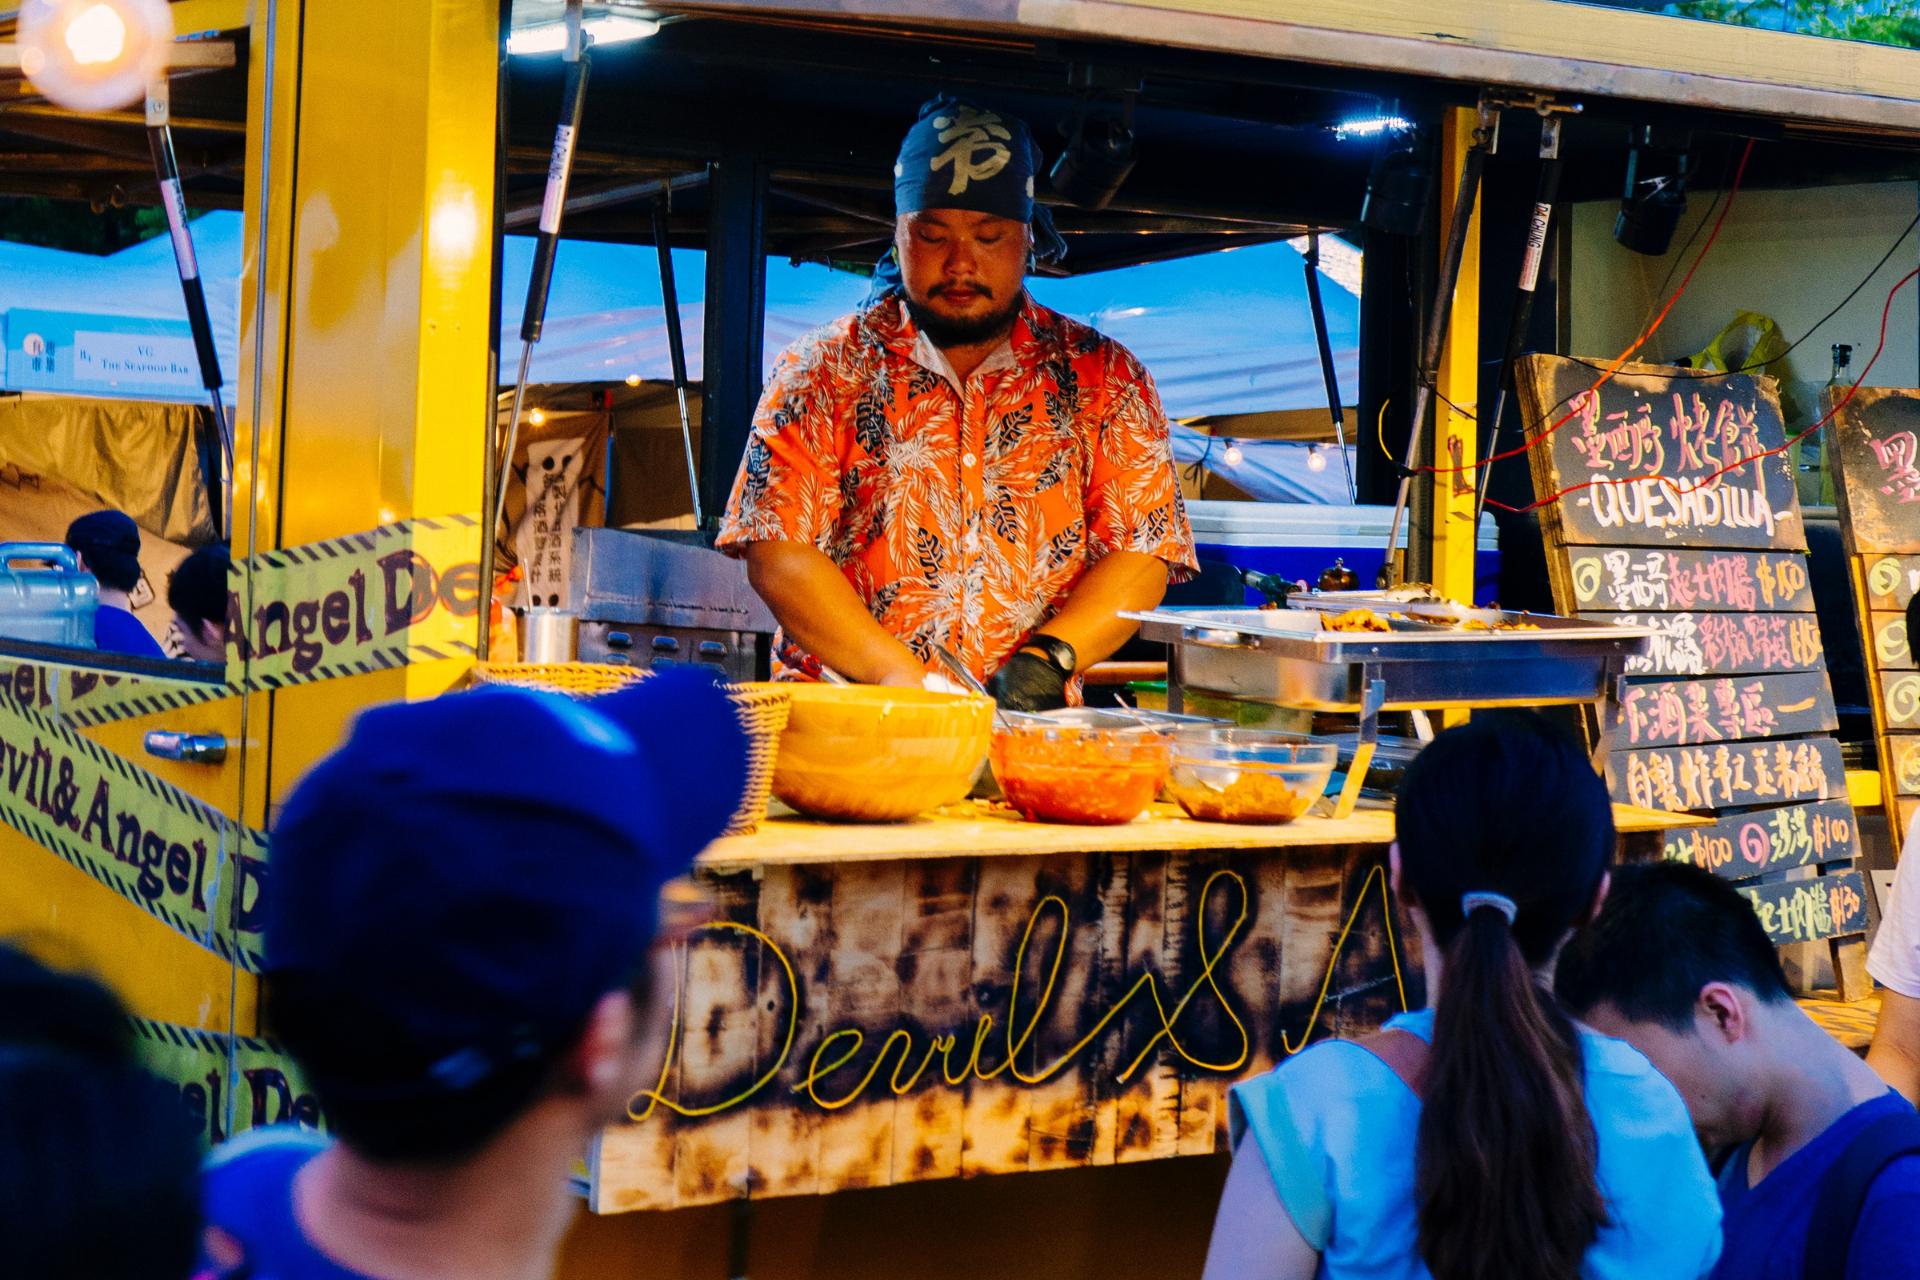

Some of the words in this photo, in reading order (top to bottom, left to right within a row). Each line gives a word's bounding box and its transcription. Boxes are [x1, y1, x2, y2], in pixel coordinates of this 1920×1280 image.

[1534, 204, 1548, 217] DA
[1528, 218, 1546, 248] CHUNG
[222, 567, 373, 675] Angel
[1812, 813, 1849, 858] $100
